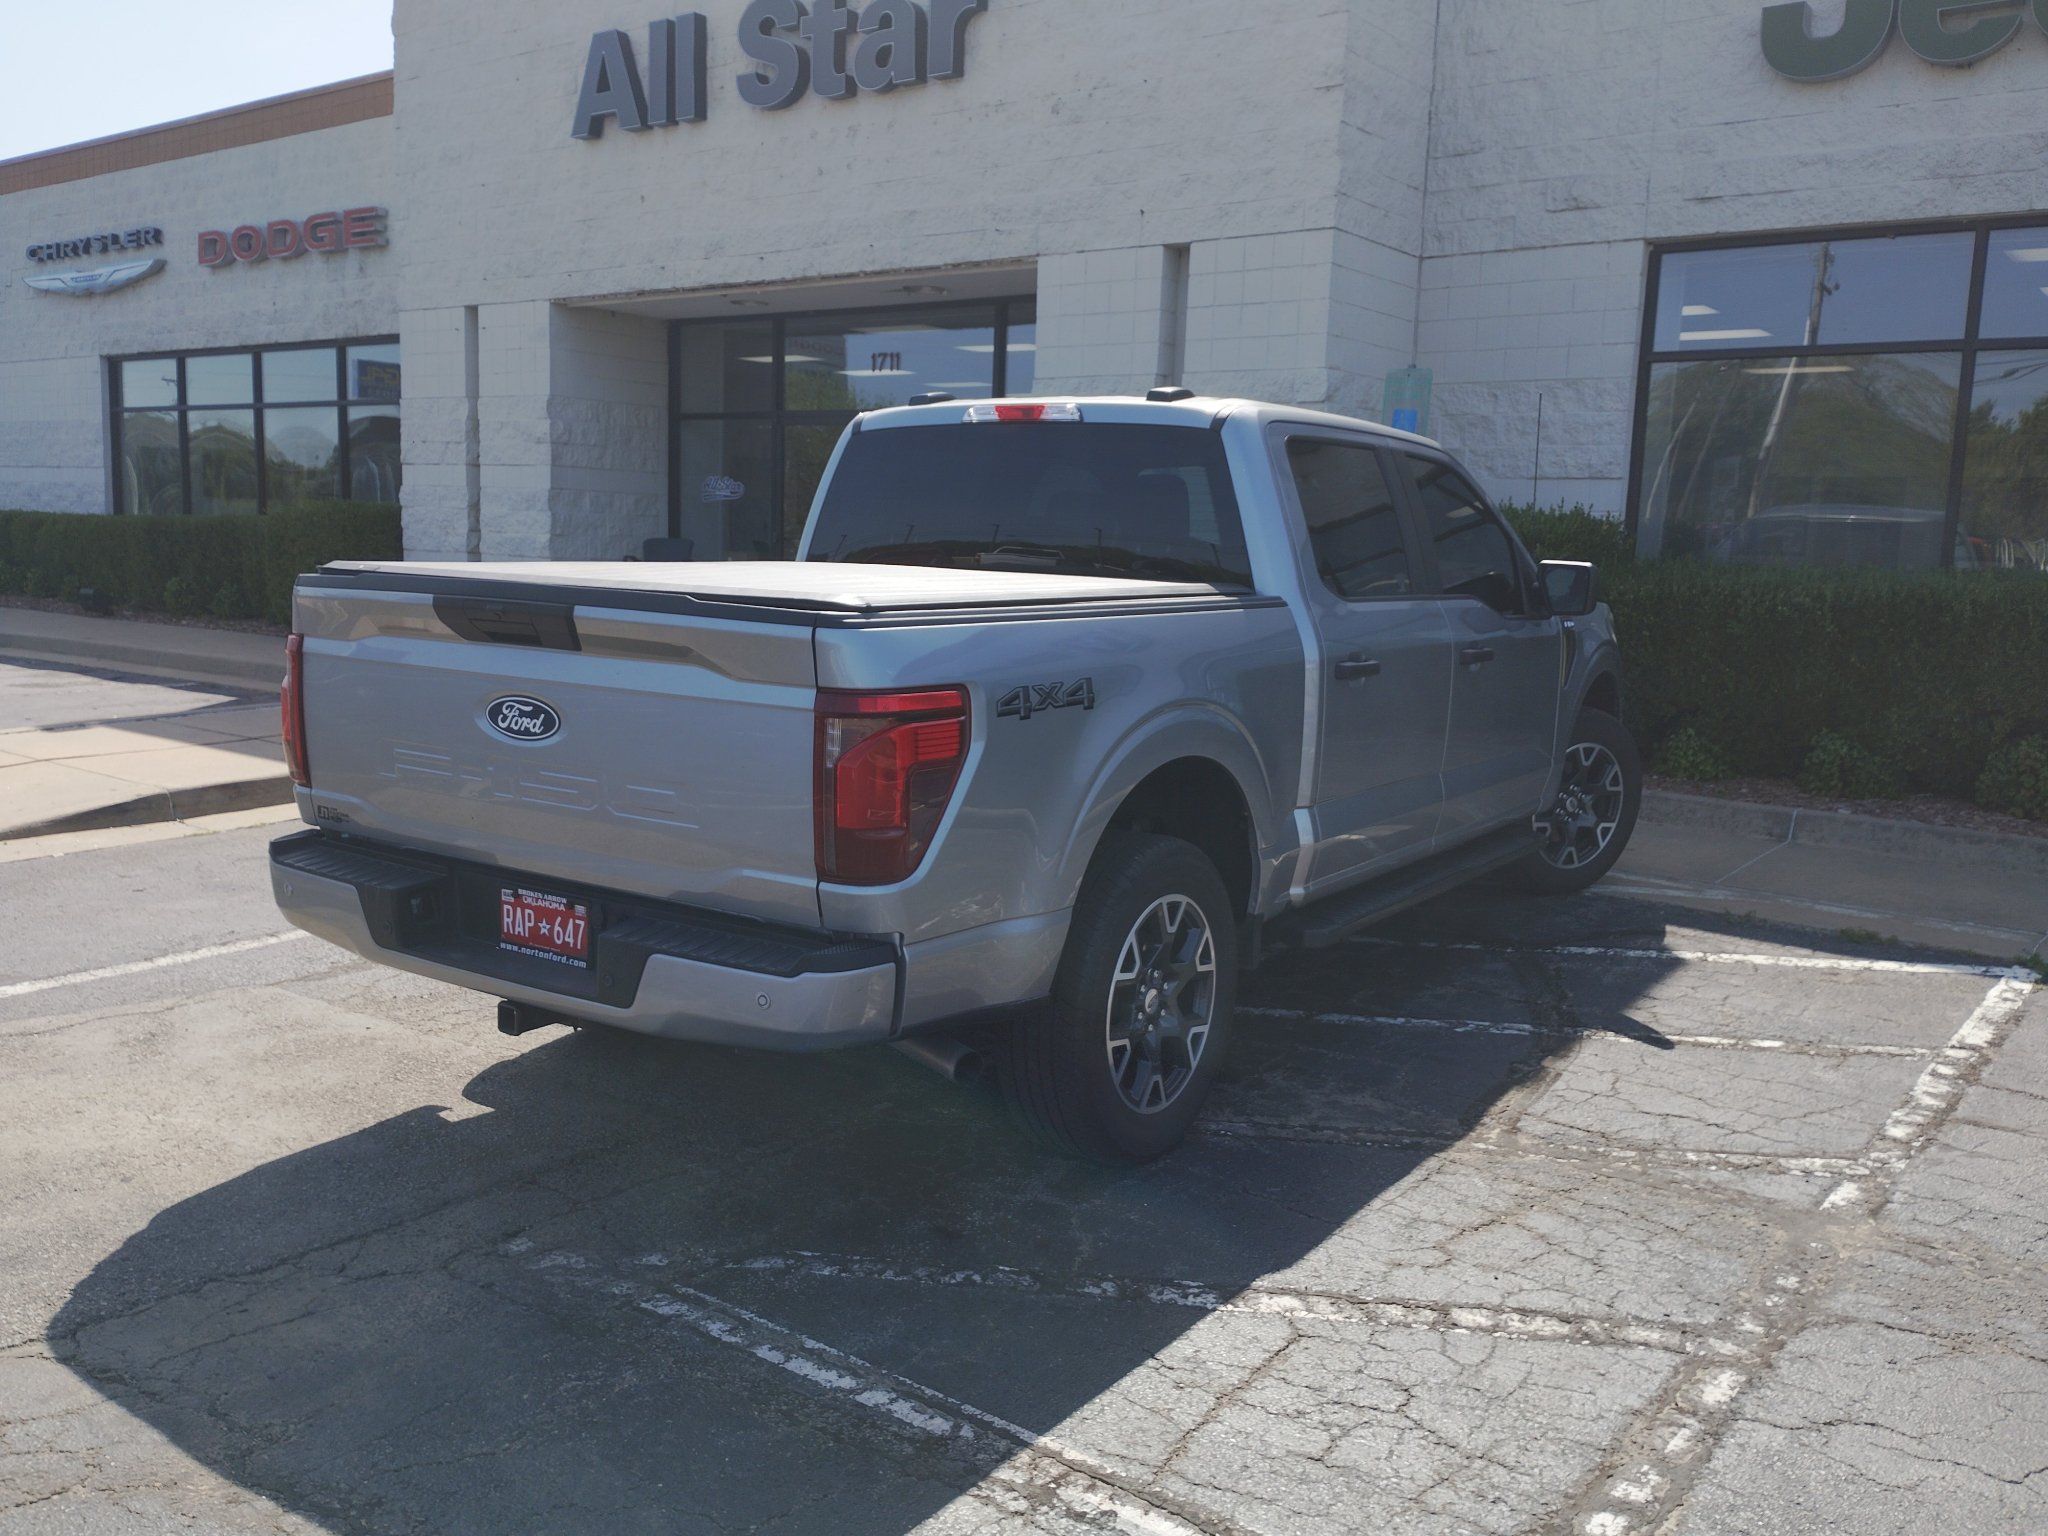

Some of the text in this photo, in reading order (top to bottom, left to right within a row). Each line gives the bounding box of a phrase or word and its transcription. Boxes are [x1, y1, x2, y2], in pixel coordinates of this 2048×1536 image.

[571, 0, 987, 140] All Star
[26, 226, 163, 263] CHRYSLER
[199, 206, 389, 267] DODGE
[871, 352, 901, 372] 1711
[497, 702, 544, 735] Ford
[523, 895, 566, 912] OKLAHOMA
[543, 894, 568, 904] ARROW
[503, 904, 585, 949] RAP 647
[500, 942, 587, 968] www.nortonford.com
